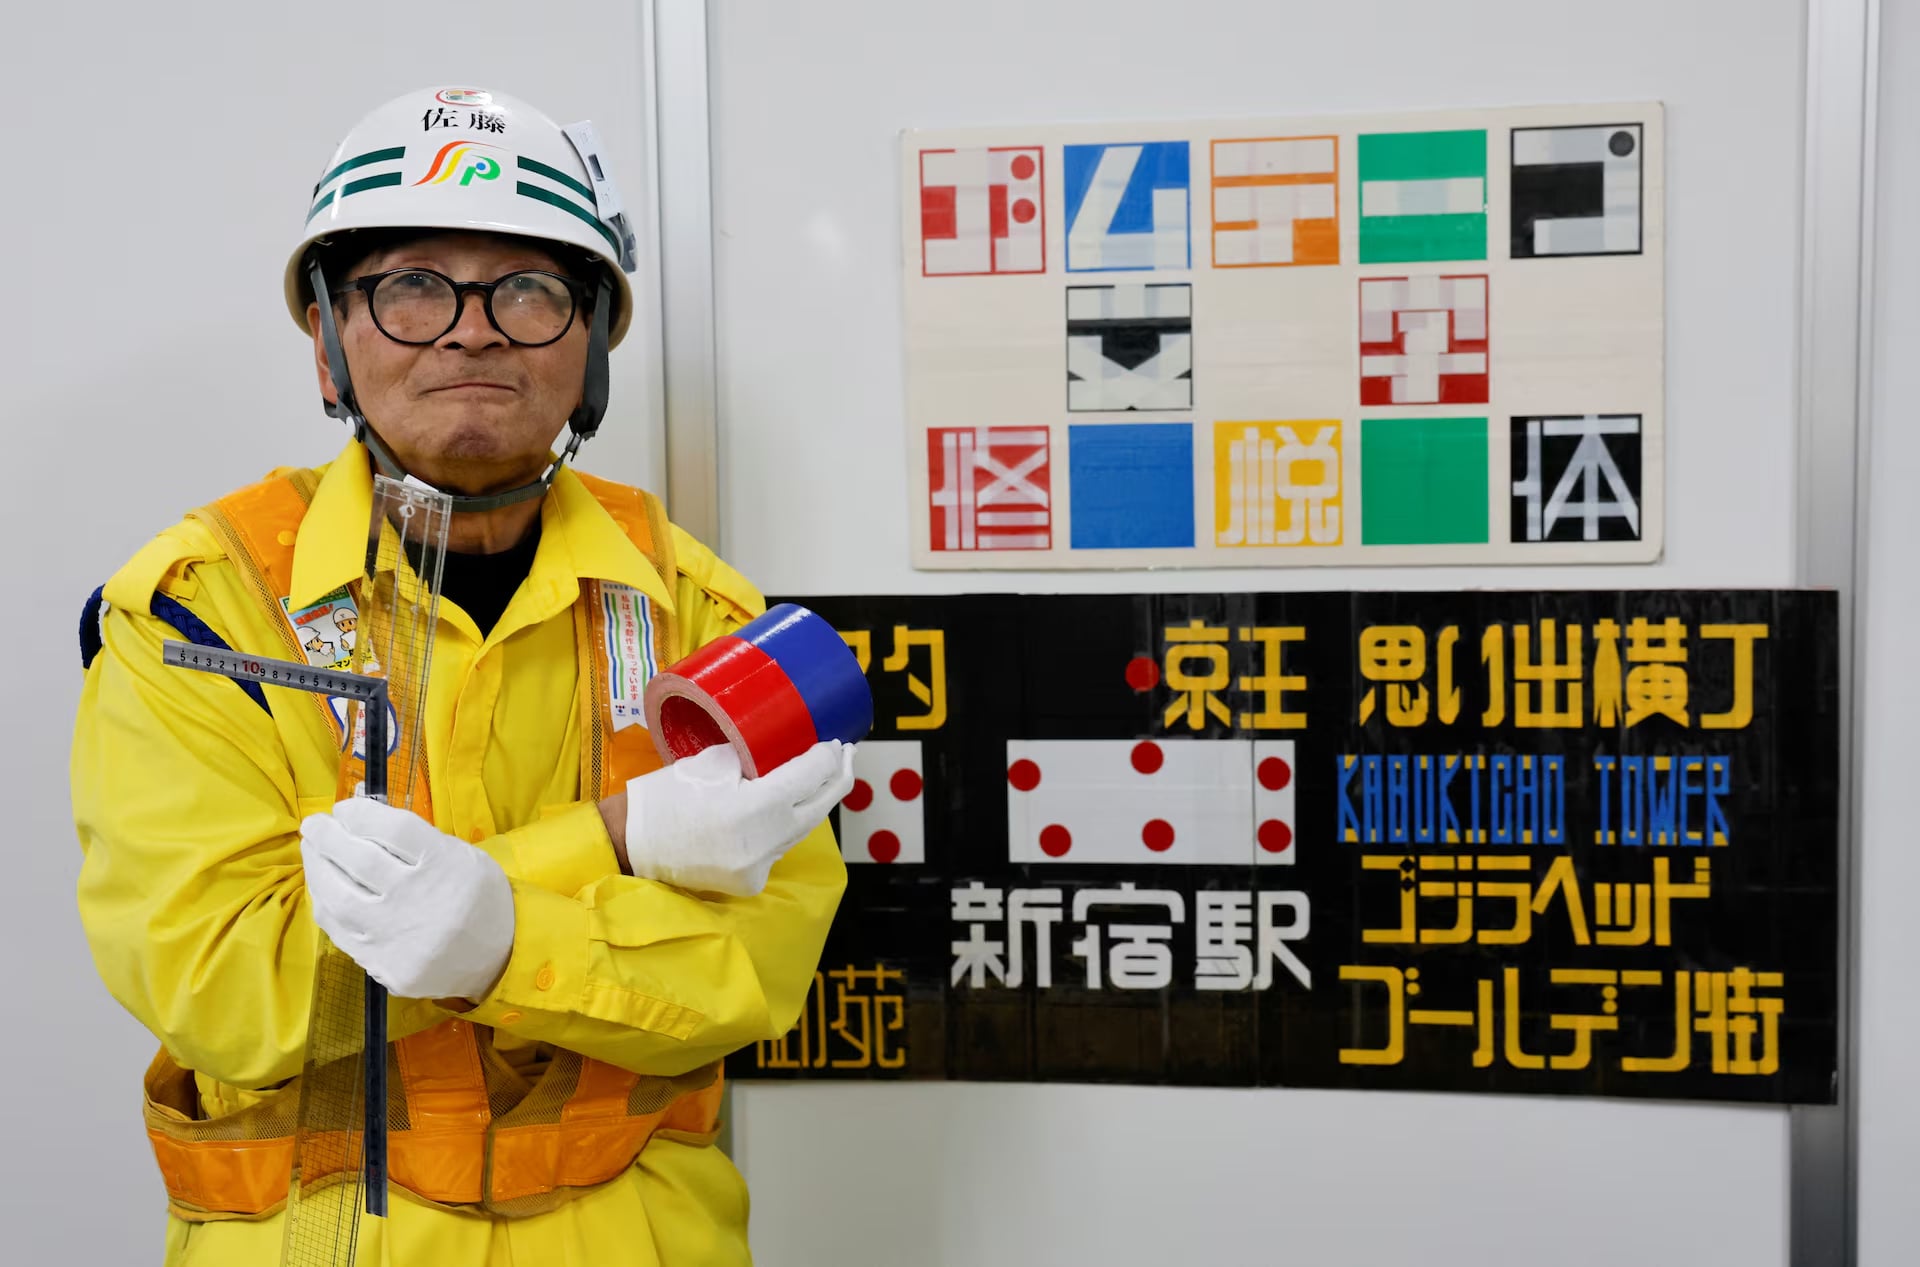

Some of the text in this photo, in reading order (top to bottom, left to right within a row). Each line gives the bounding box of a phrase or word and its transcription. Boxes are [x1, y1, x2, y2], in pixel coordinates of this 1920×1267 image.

[421, 107, 507, 134] 佐藤
[180, 653, 186, 662] 5
[192, 656, 199, 665] 4
[206, 658, 212, 667] 3
[219, 660, 225, 669] 2
[242, 660, 260, 674] 10
[260, 668, 266, 677] 9
[272, 670, 278, 679] 8
[286, 672, 292, 681] 7
[299, 675, 306, 684] 6
[313, 678, 319, 687] 5
[326, 680, 333, 689] 4
[340, 682, 347, 691] 3
[354, 685, 361, 694] 2
[1164, 620, 1307, 731] 京王
[1359, 617, 1768, 730] 思い出横丁
[1336, 755, 1730, 847] KABUKICHO TOWER
[951, 881, 1312, 992] 新宿駅
[1361, 855, 1710, 946] ゴジラヘッド
[1339, 965, 1784, 1076] ゴールデン街
